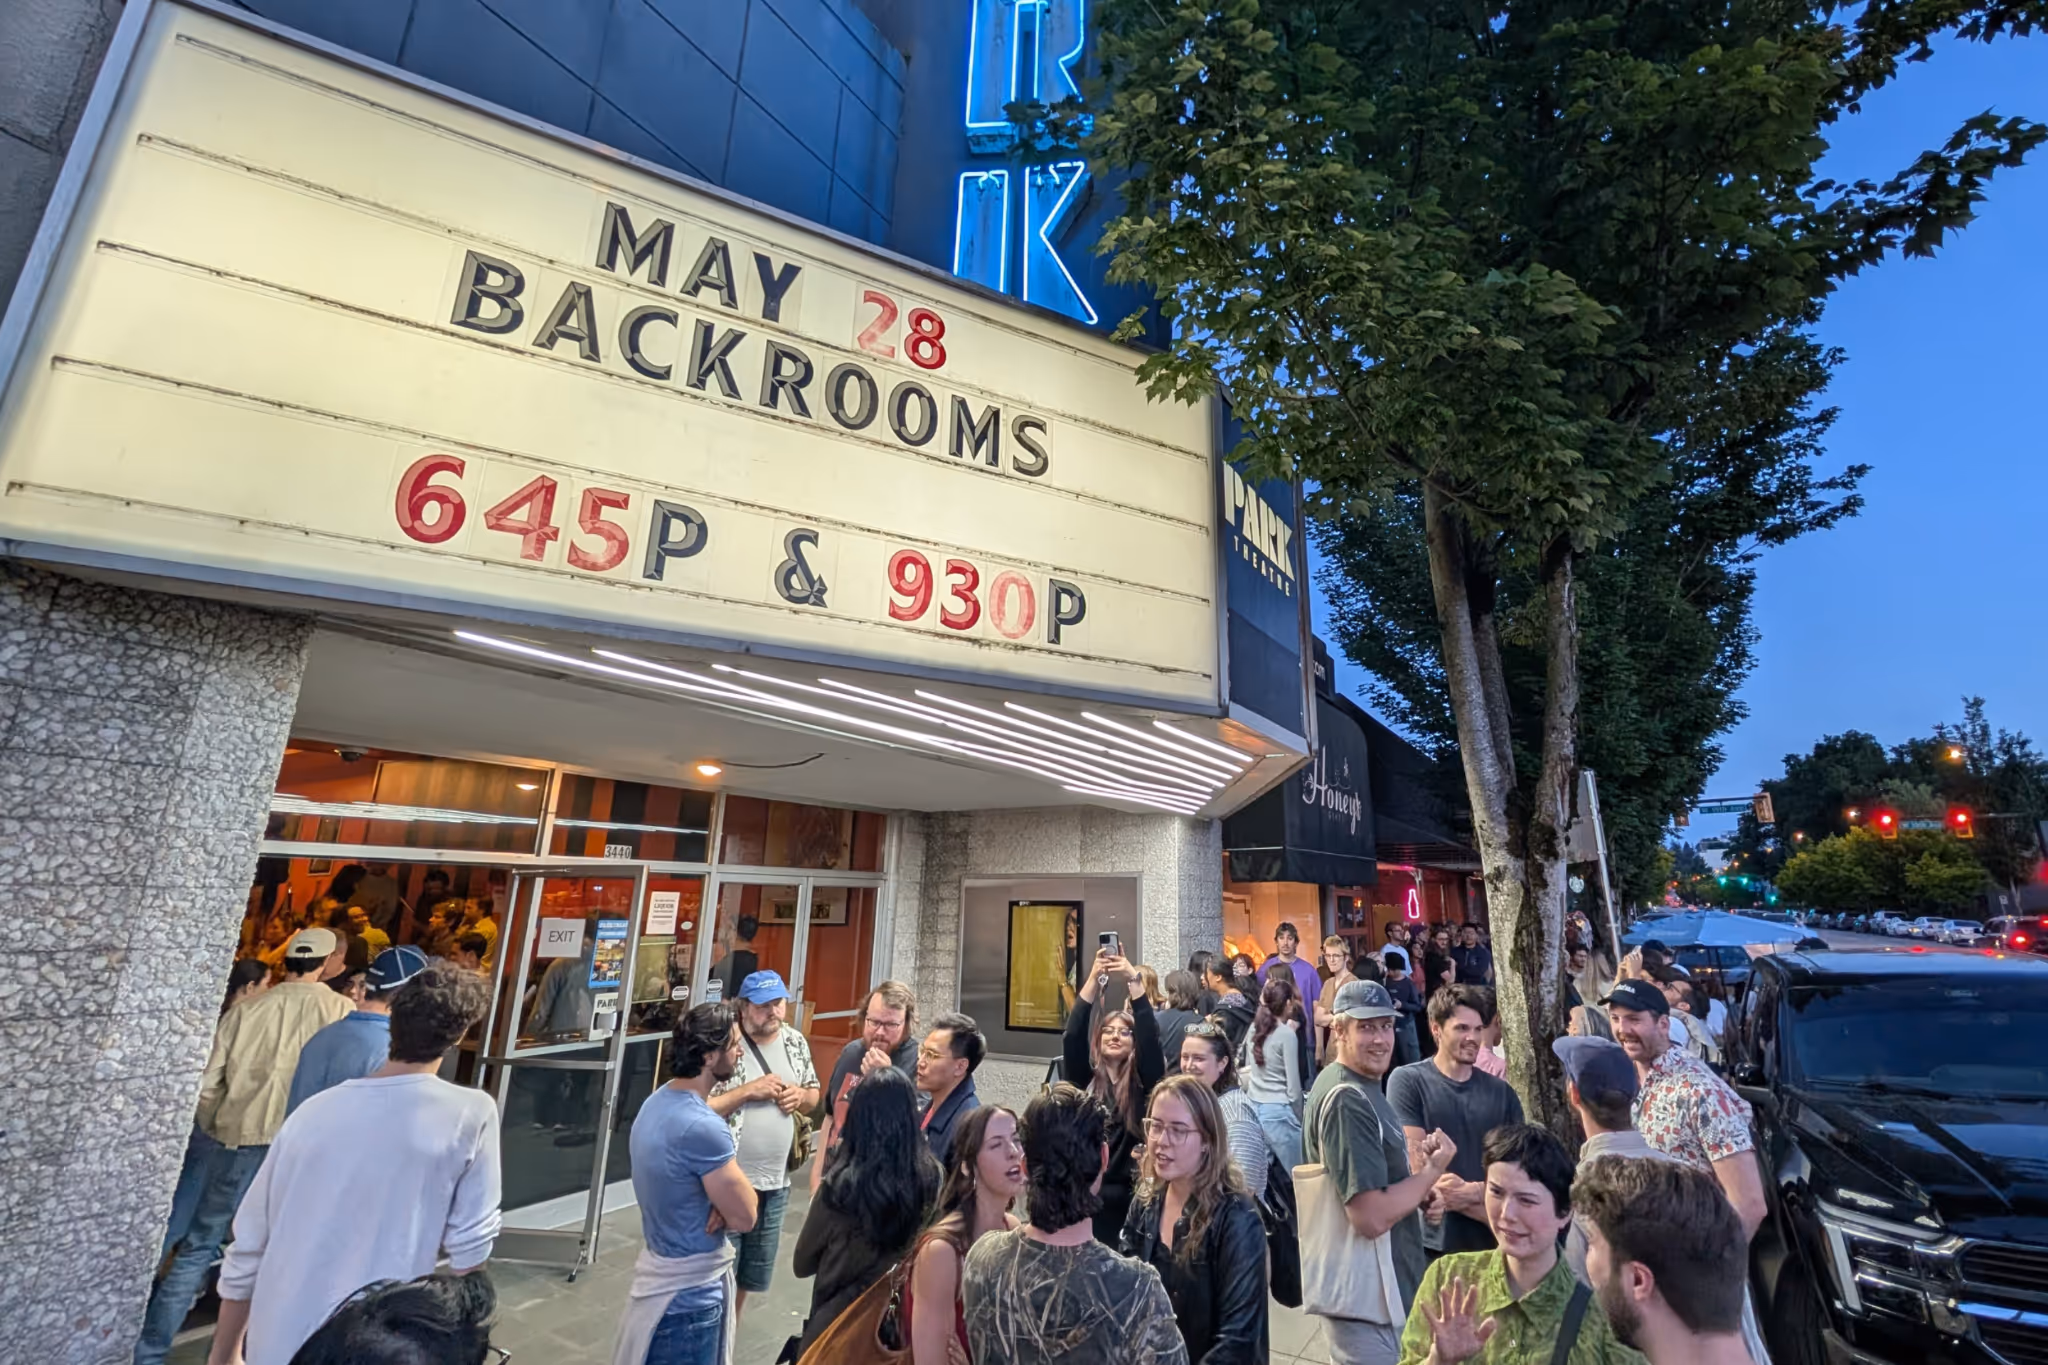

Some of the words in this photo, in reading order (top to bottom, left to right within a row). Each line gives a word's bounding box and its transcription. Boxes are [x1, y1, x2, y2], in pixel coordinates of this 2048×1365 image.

[594, 200, 802, 323] MAY
[856, 290, 947, 371] 28
[449, 249, 1050, 478] BACKROOMS
[1223, 460, 1296, 582] PARK
[1233, 535, 1291, 597] THEATRE
[773, 527, 829, 608] &
[887, 549, 1087, 645] 930P
[605, 845, 632, 859] 3440
[548, 930, 576, 943] EXIT
